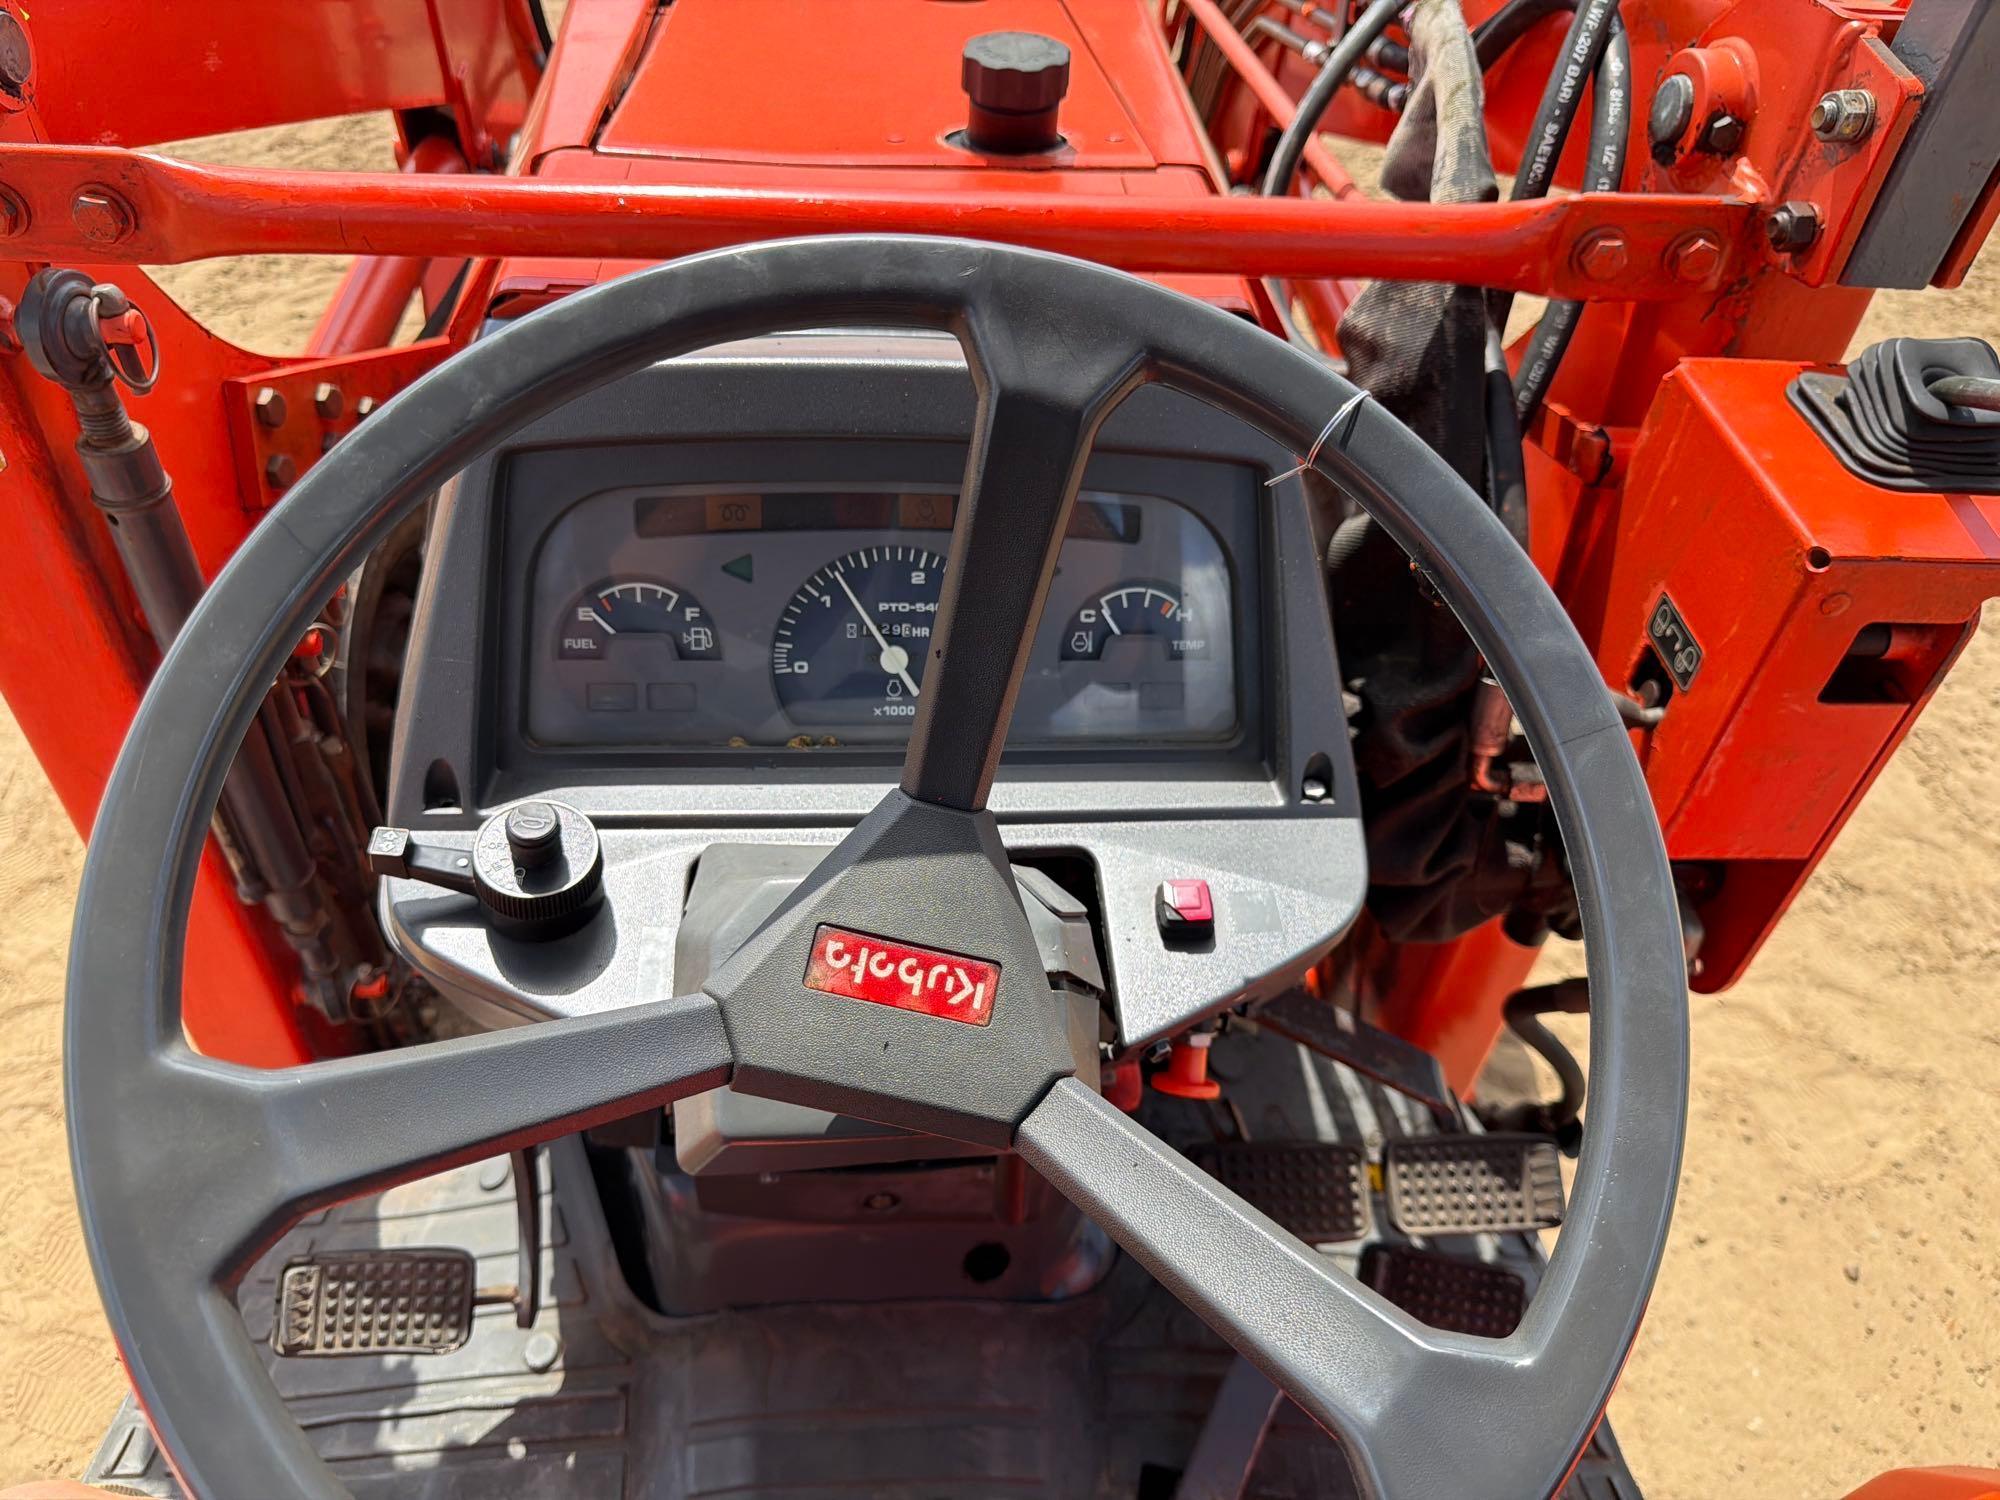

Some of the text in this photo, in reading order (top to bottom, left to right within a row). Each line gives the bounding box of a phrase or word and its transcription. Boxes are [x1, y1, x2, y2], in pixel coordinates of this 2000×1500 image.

[910, 572, 926, 585] 2
[820, 595, 832, 609] 1
[577, 608, 594, 621] E
[685, 608, 701, 621] F
[1079, 609, 1097, 623] C
[1176, 609, 1193, 622] H
[912, 626, 930, 638] HR
[564, 638, 597, 650] FUEL
[1172, 640, 1206, 651] TEMP
[793, 660, 810, 674] 0
[825, 939, 986, 1010] Kubota
